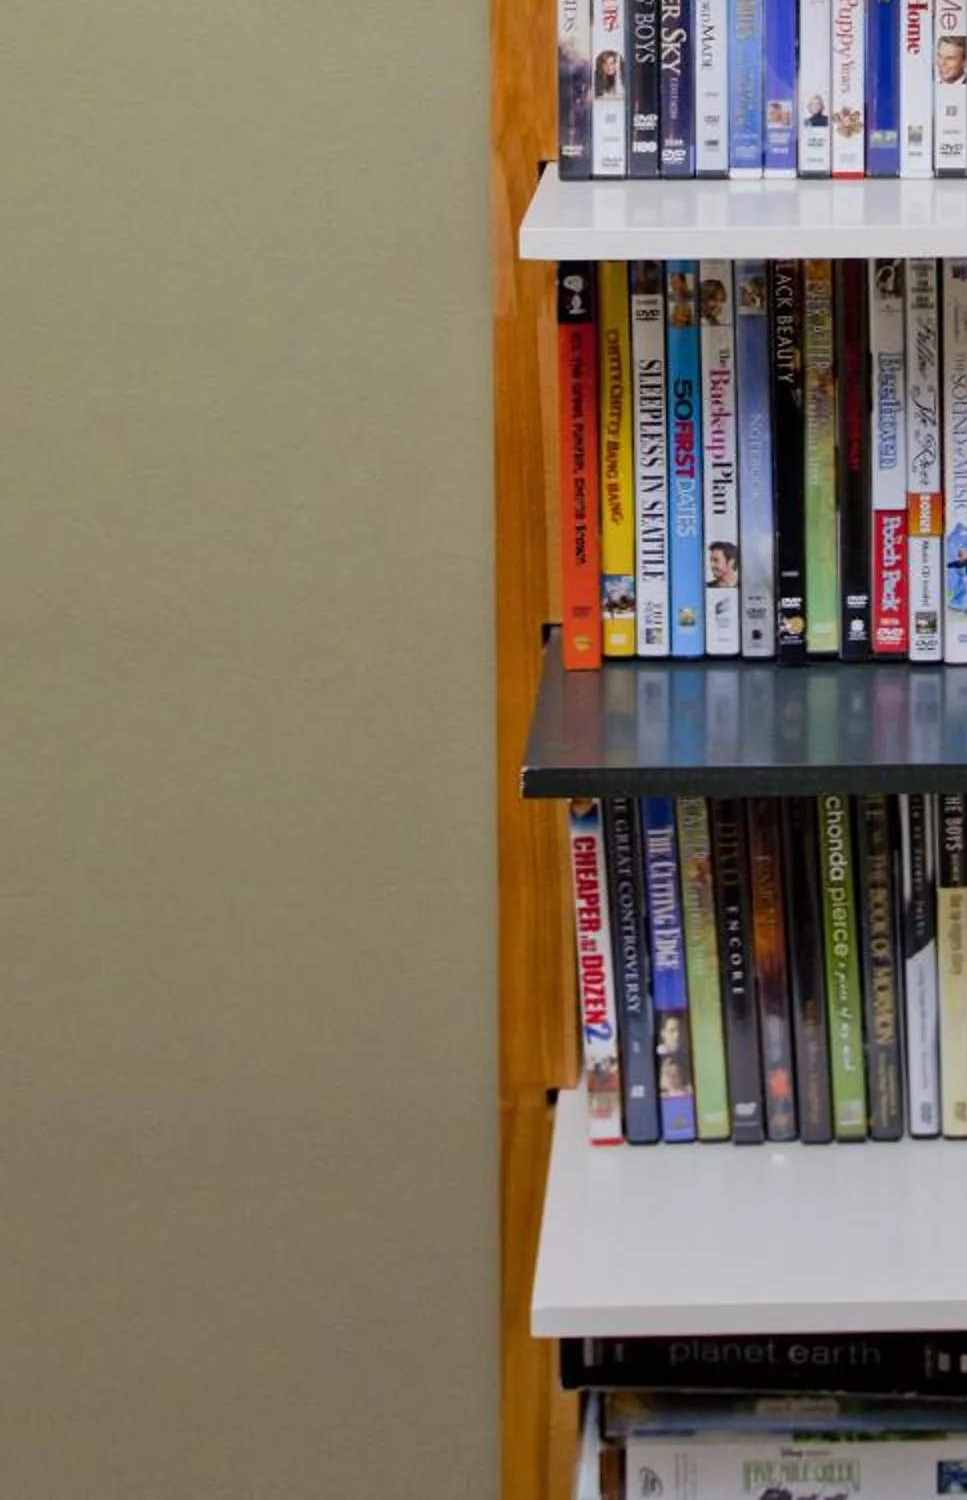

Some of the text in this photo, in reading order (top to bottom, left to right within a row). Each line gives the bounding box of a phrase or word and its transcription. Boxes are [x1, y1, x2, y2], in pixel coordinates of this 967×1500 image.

[634, 14, 657, 63] BOYS
[662, 28, 686, 76] SKY
[775, 263, 794, 384] LACK BEAUTY
[605, 329, 624, 525] CHITTY CHITTY BANG BANG
[673, 380, 696, 537] 50 FIRST DATES
[877, 352, 904, 470] Beethoven
[638, 359, 666, 581] SLEEPLESS IN SEATTLE
[574, 836, 601, 934] CHEAPER
[614, 819, 630, 875] GREAT
[647, 825, 681, 971] THE CUTTING EDGE
[825, 797, 850, 955] chonda pierce
[618, 883, 640, 1013] CONTROVERSY
[867, 888, 888, 934] BOOK
[582, 955, 607, 1025] DOZEN
[584, 1022, 612, 1044] 2
[669, 1339, 883, 1367] planet earth
